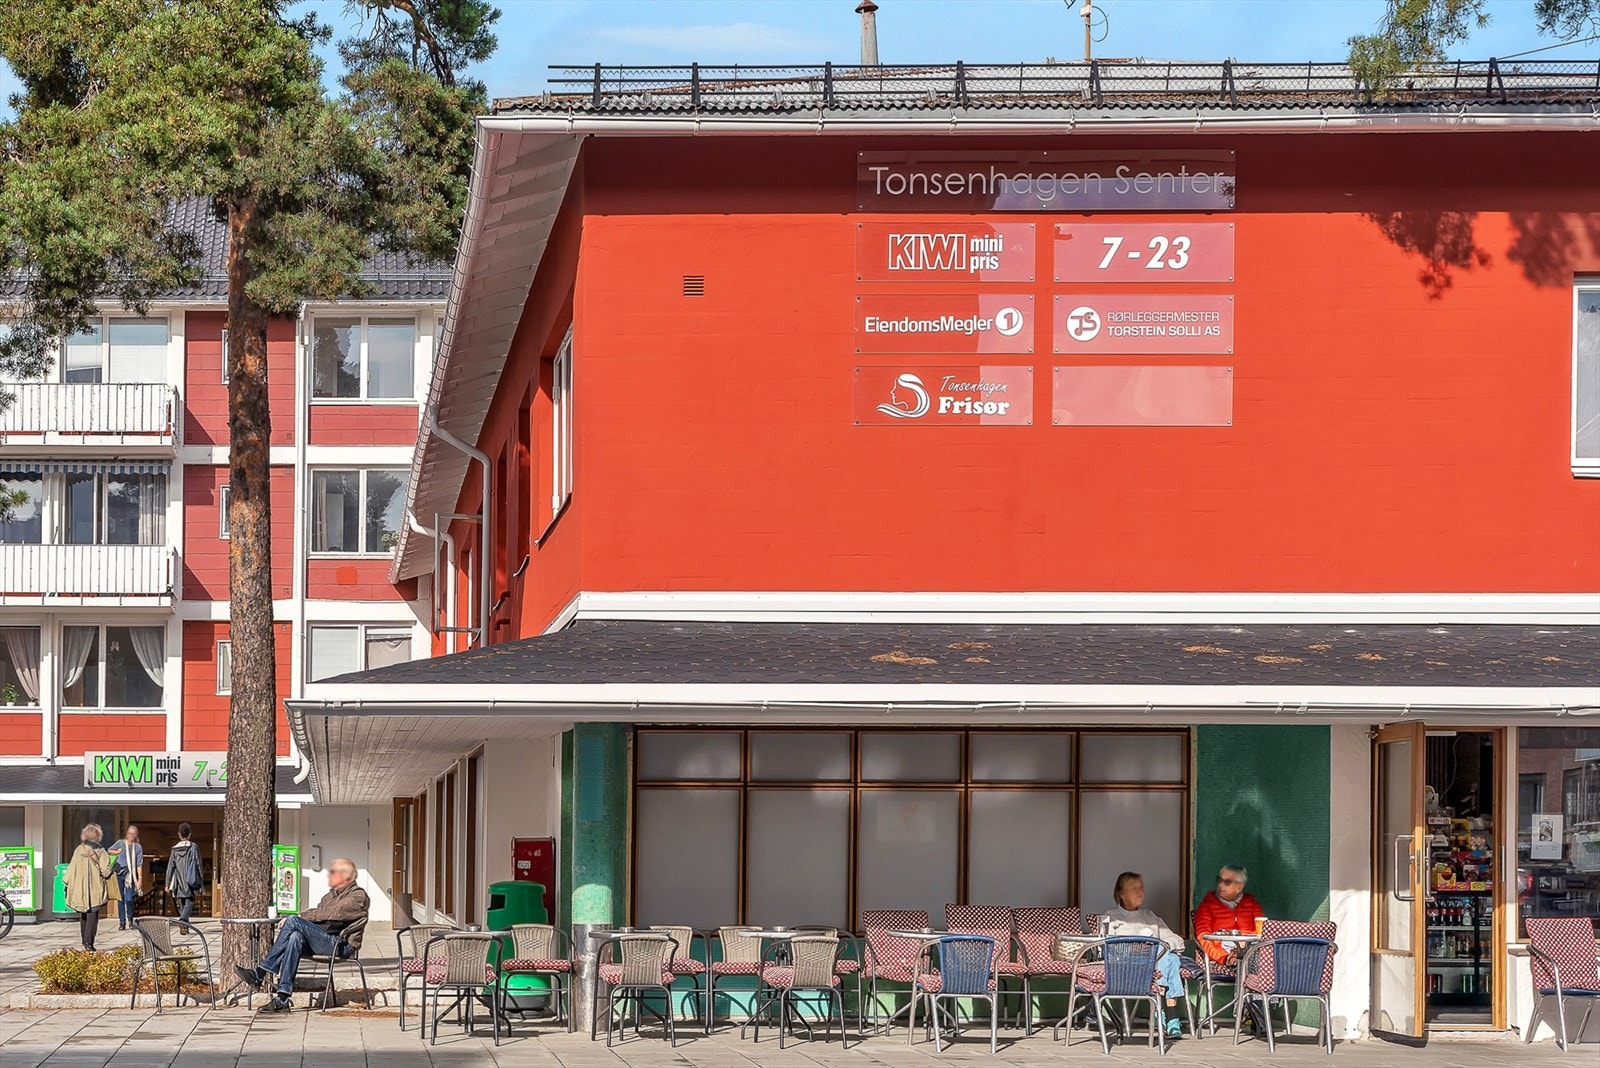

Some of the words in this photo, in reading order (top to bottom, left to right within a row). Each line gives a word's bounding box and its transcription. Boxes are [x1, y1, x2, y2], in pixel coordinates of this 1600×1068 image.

[868, 165, 1102, 201] Tonsenhagen
[1114, 165, 1225, 195] Senter
[888, 233, 967, 270] KIWI
[969, 235, 1003, 252] mini
[969, 253, 999, 274] pris
[865, 315, 993, 335] EiendomsMegler
[1107, 312, 1220, 322] RØRLEGGERMESTER
[1107, 325, 1166, 337] TORSTEIN
[1168, 325, 1201, 337] SOLLI
[1203, 325, 1220, 336] AS
[940, 375, 1008, 398] Tonsenhagen
[937, 396, 1010, 416] Frisør
[94, 755, 153, 783] KIWI
[156, 756, 181, 769] mini
[156, 770, 178, 786] pris
